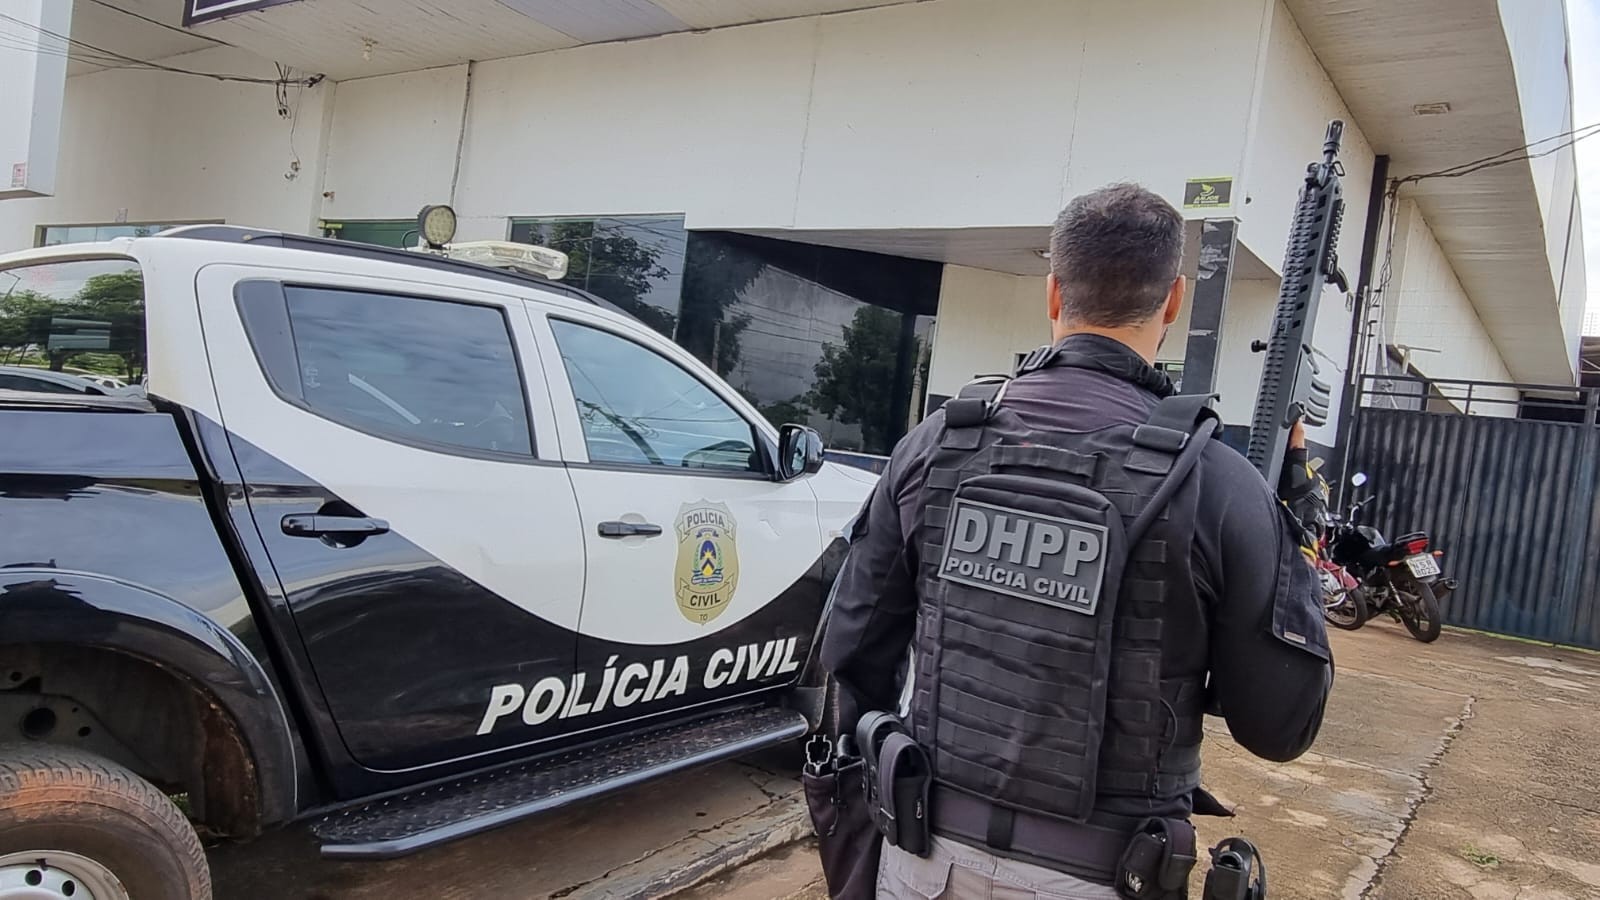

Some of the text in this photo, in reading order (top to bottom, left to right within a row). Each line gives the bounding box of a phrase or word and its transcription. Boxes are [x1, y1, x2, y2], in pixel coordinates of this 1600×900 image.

[687, 509, 725, 528] POLÍCIA
[952, 507, 1100, 577] DHPP
[690, 593, 721, 607] CIVIL
[945, 557, 1090, 605] POLÍCIA CIVIL
[477, 637, 800, 736] POLÍCIA CIVIL
